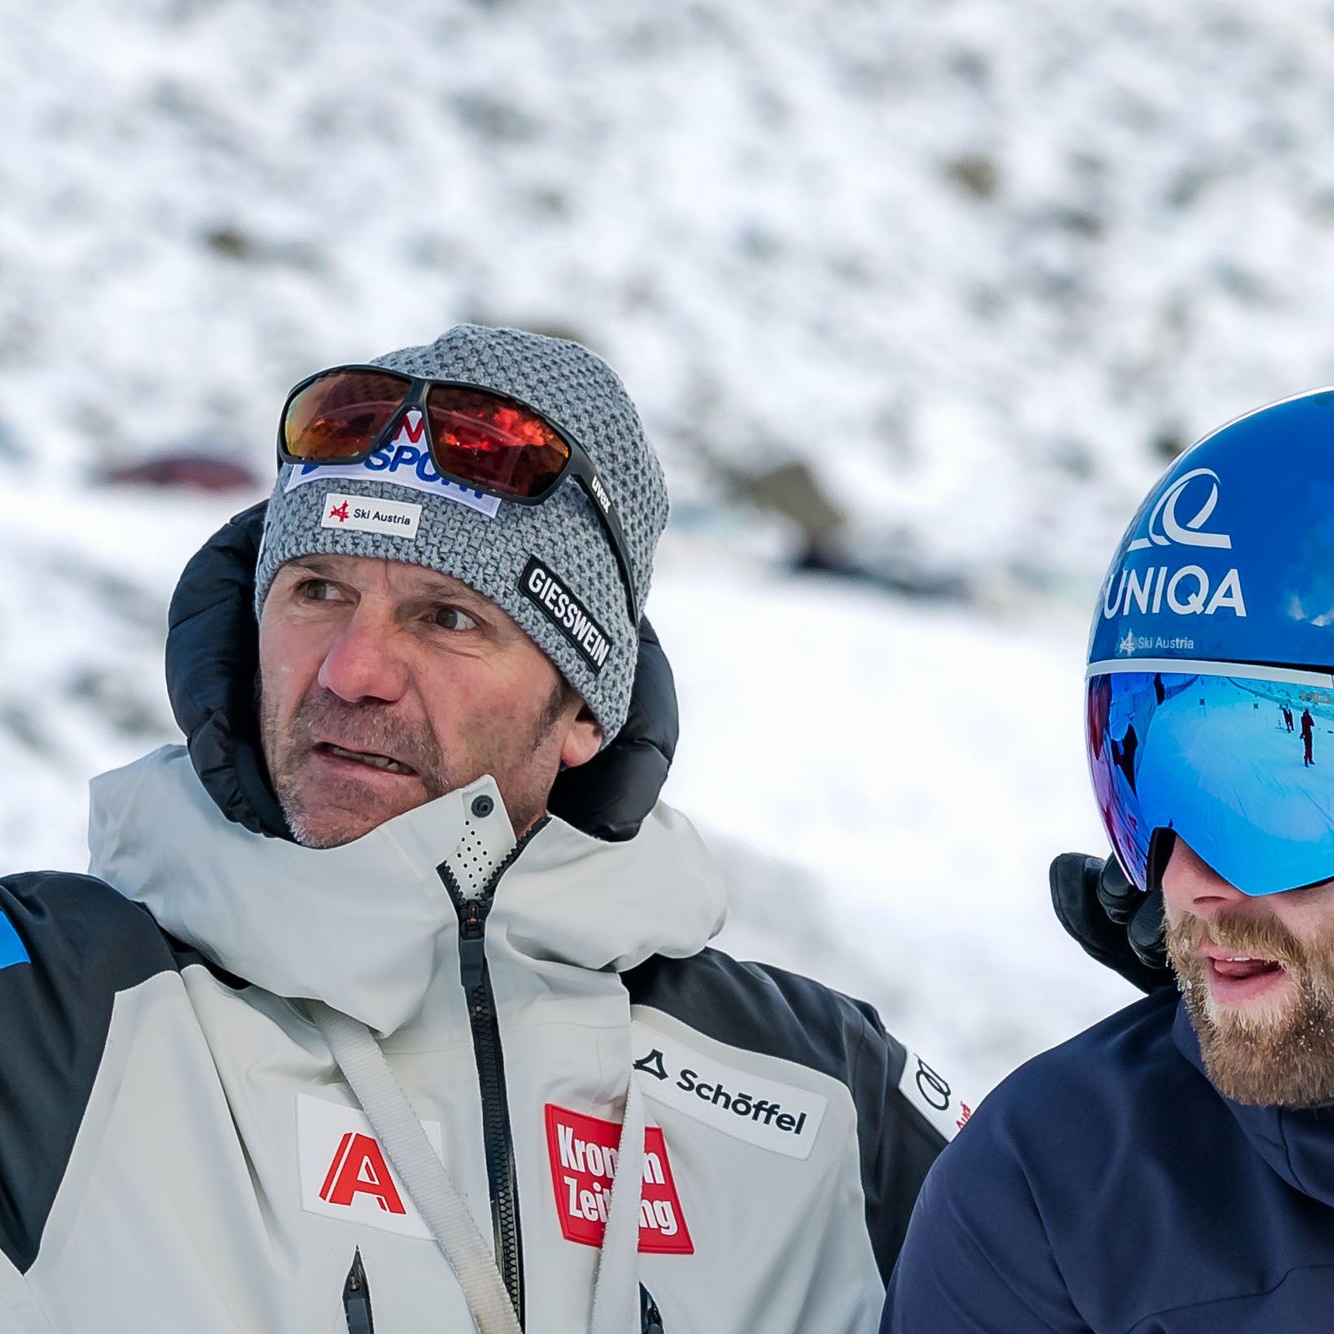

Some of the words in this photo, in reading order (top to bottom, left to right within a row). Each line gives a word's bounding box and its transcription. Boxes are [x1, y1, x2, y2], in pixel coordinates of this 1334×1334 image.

[353, 508, 371, 521] Ski
[372, 510, 411, 527] Austria
[592, 475, 611, 514] uvex
[528, 568, 610, 667] GIESSWEIN
[1103, 564, 1247, 619] UNIQA
[1138, 637, 1153, 649] Ski
[1155, 637, 1194, 649] Austria
[557, 1123, 666, 1184] Kronn
[563, 1174, 678, 1236] Zeing
